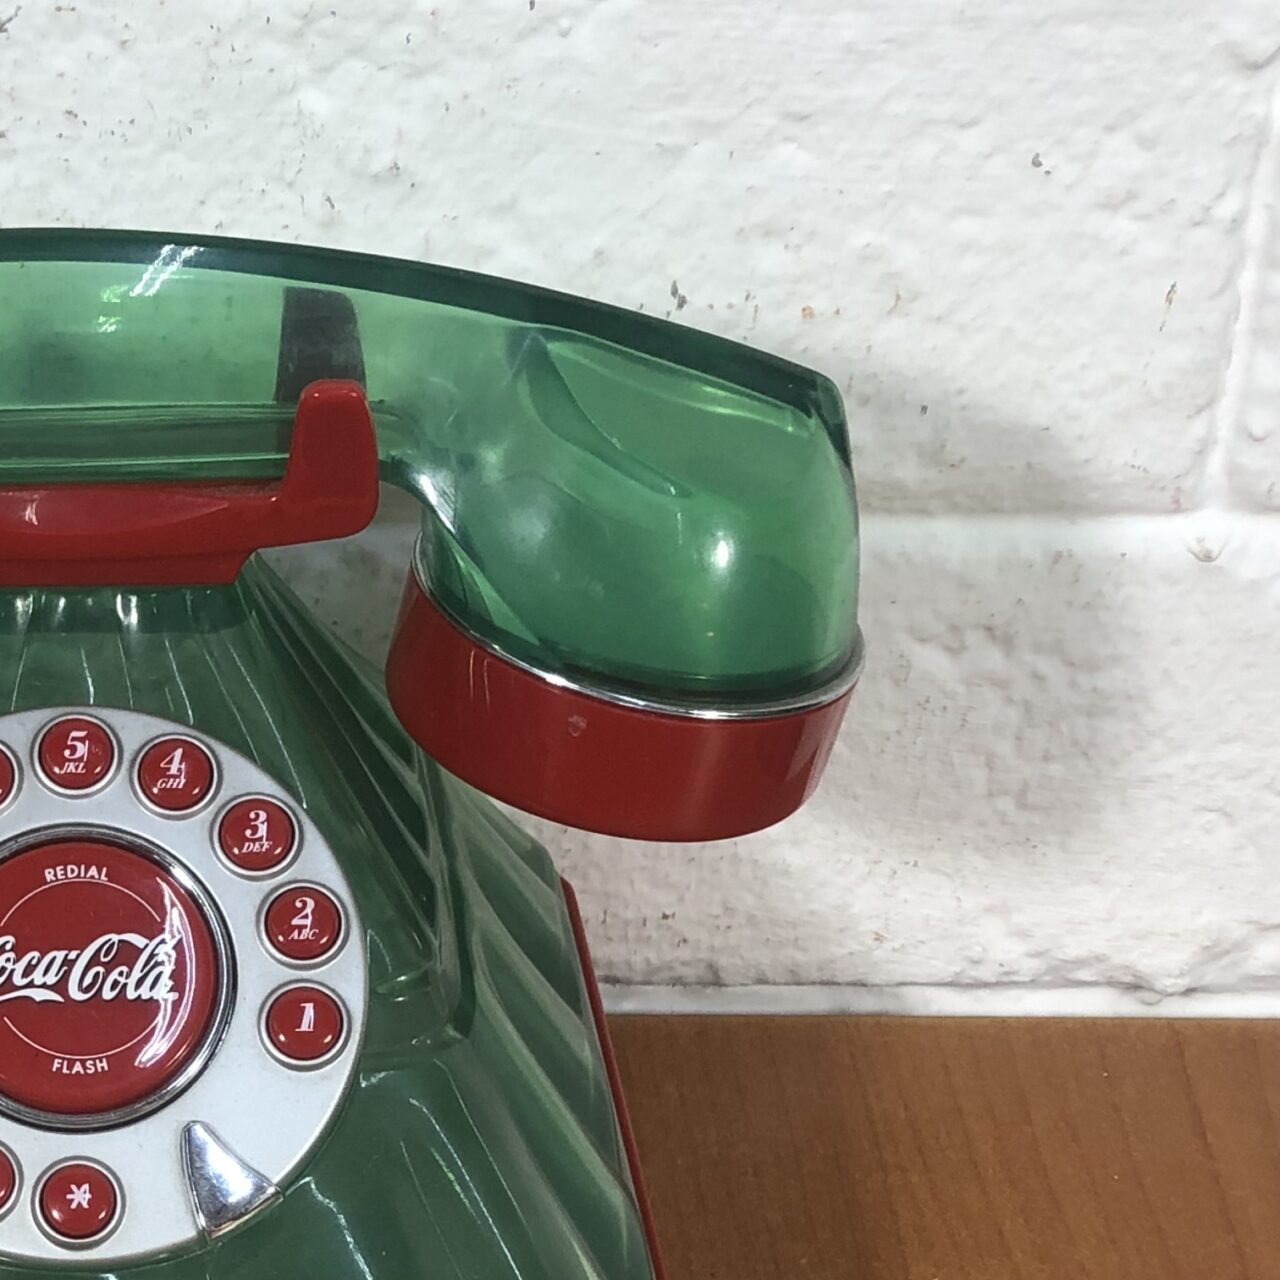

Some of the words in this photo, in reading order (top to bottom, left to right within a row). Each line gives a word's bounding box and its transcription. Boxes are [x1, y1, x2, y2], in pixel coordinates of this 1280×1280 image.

[63, 730, 88, 760] 5
[60, 761, 87, 775] JKL
[159, 747, 185, 776] 4
[244, 809, 268, 839] 3
[241, 840, 273, 854] DEF
[45, 864, 109, 883] REDIAL
[290, 896, 316, 926] 2
[288, 928, 319, 941] ABC
[294, 1002, 316, 1032] 1
[52, 1058, 109, 1075] FLASH
